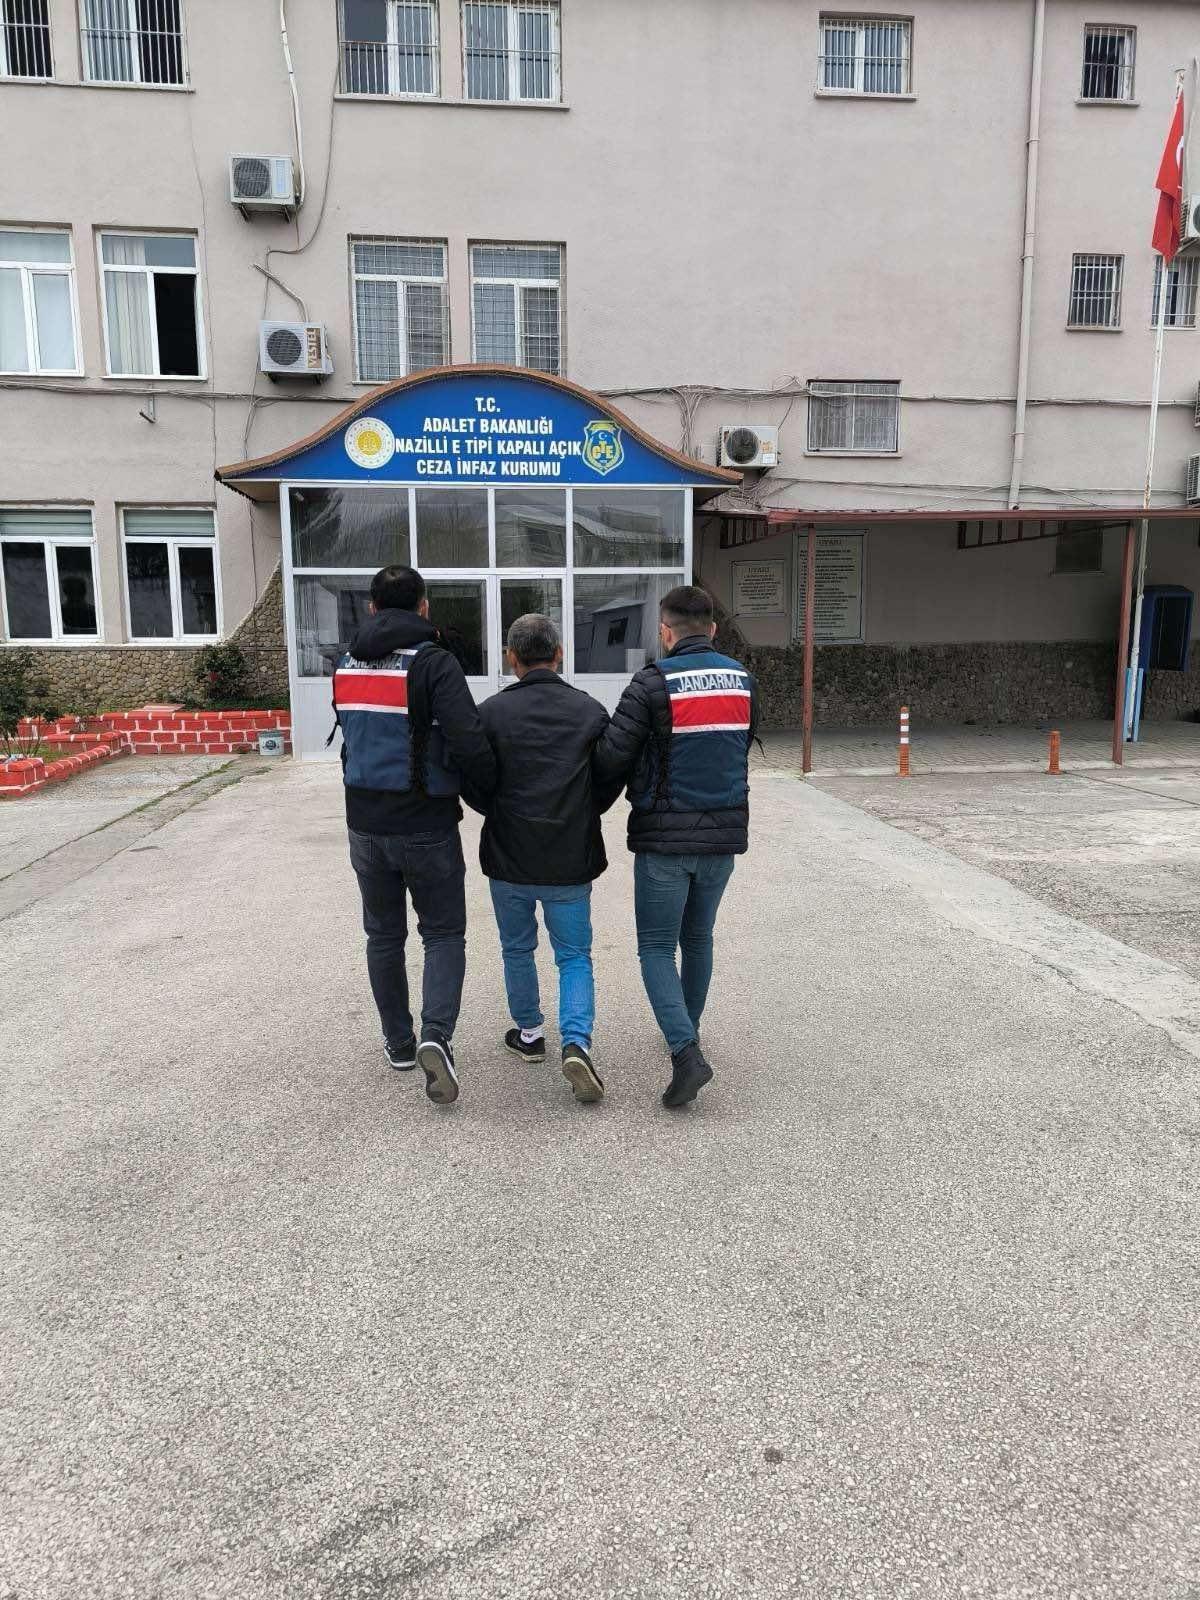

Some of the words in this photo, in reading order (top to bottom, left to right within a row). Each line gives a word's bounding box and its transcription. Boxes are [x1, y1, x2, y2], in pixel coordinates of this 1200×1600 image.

[307, 328, 318, 368] VESTEL
[475, 397, 501, 412] T.C.
[423, 417, 476, 433] ADALET
[480, 416, 553, 434] BAKANLIĞI
[395, 436, 448, 454] NAZİLLİ
[452, 440, 460, 454] E
[465, 436, 493, 454] TİPİ
[497, 440, 545, 455] KAPALI
[549, 440, 582, 459] AÇIK
[416, 459, 453, 475] CEZA
[456, 457, 497, 475] İNFAZ
[501, 461, 561, 476] KURUMU
[677, 674, 744, 692] JANDARMA
